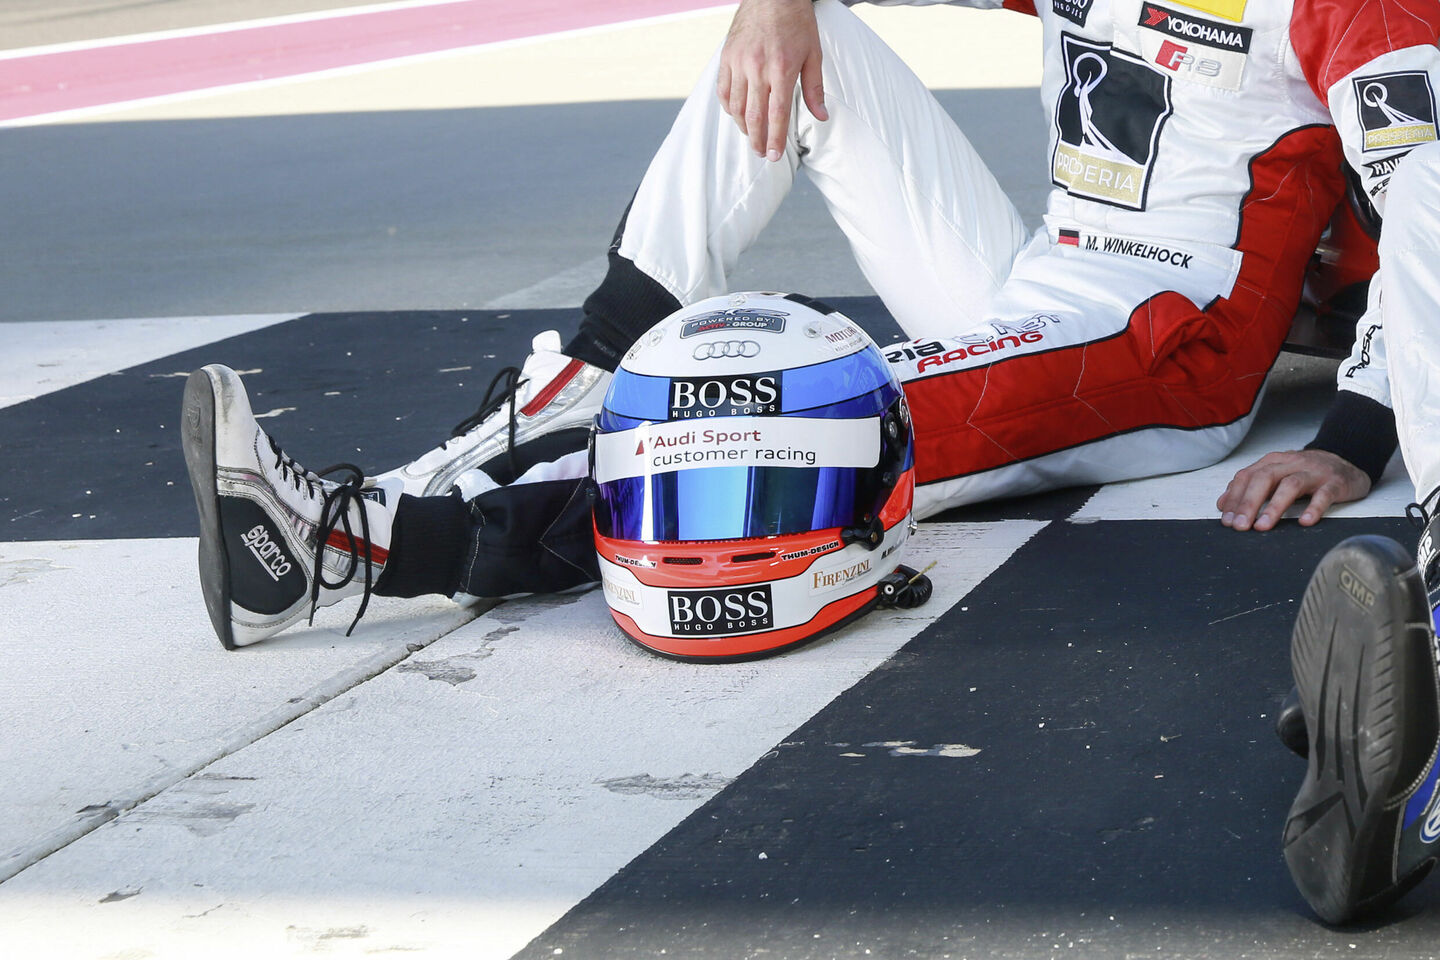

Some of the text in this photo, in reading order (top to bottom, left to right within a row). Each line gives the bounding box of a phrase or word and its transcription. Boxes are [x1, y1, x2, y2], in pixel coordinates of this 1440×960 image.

[1166, 14, 1244, 48] YOKOHAMA
[1085, 236, 1194, 270] M. WINKELHOCK
[671, 376, 778, 410] BOSS
[672, 404, 776, 419] HUGO BOSS
[654, 429, 762, 449] Audi Sport
[653, 446, 817, 468] customer racing
[243, 524, 293, 577] sparco
[781, 540, 840, 561] THUM-DESIGN
[812, 558, 870, 589] FIRENZINI
[1339, 571, 1376, 609] OMP
[670, 590, 770, 624] BOSS
[673, 616, 770, 633] HUGO BOSS
